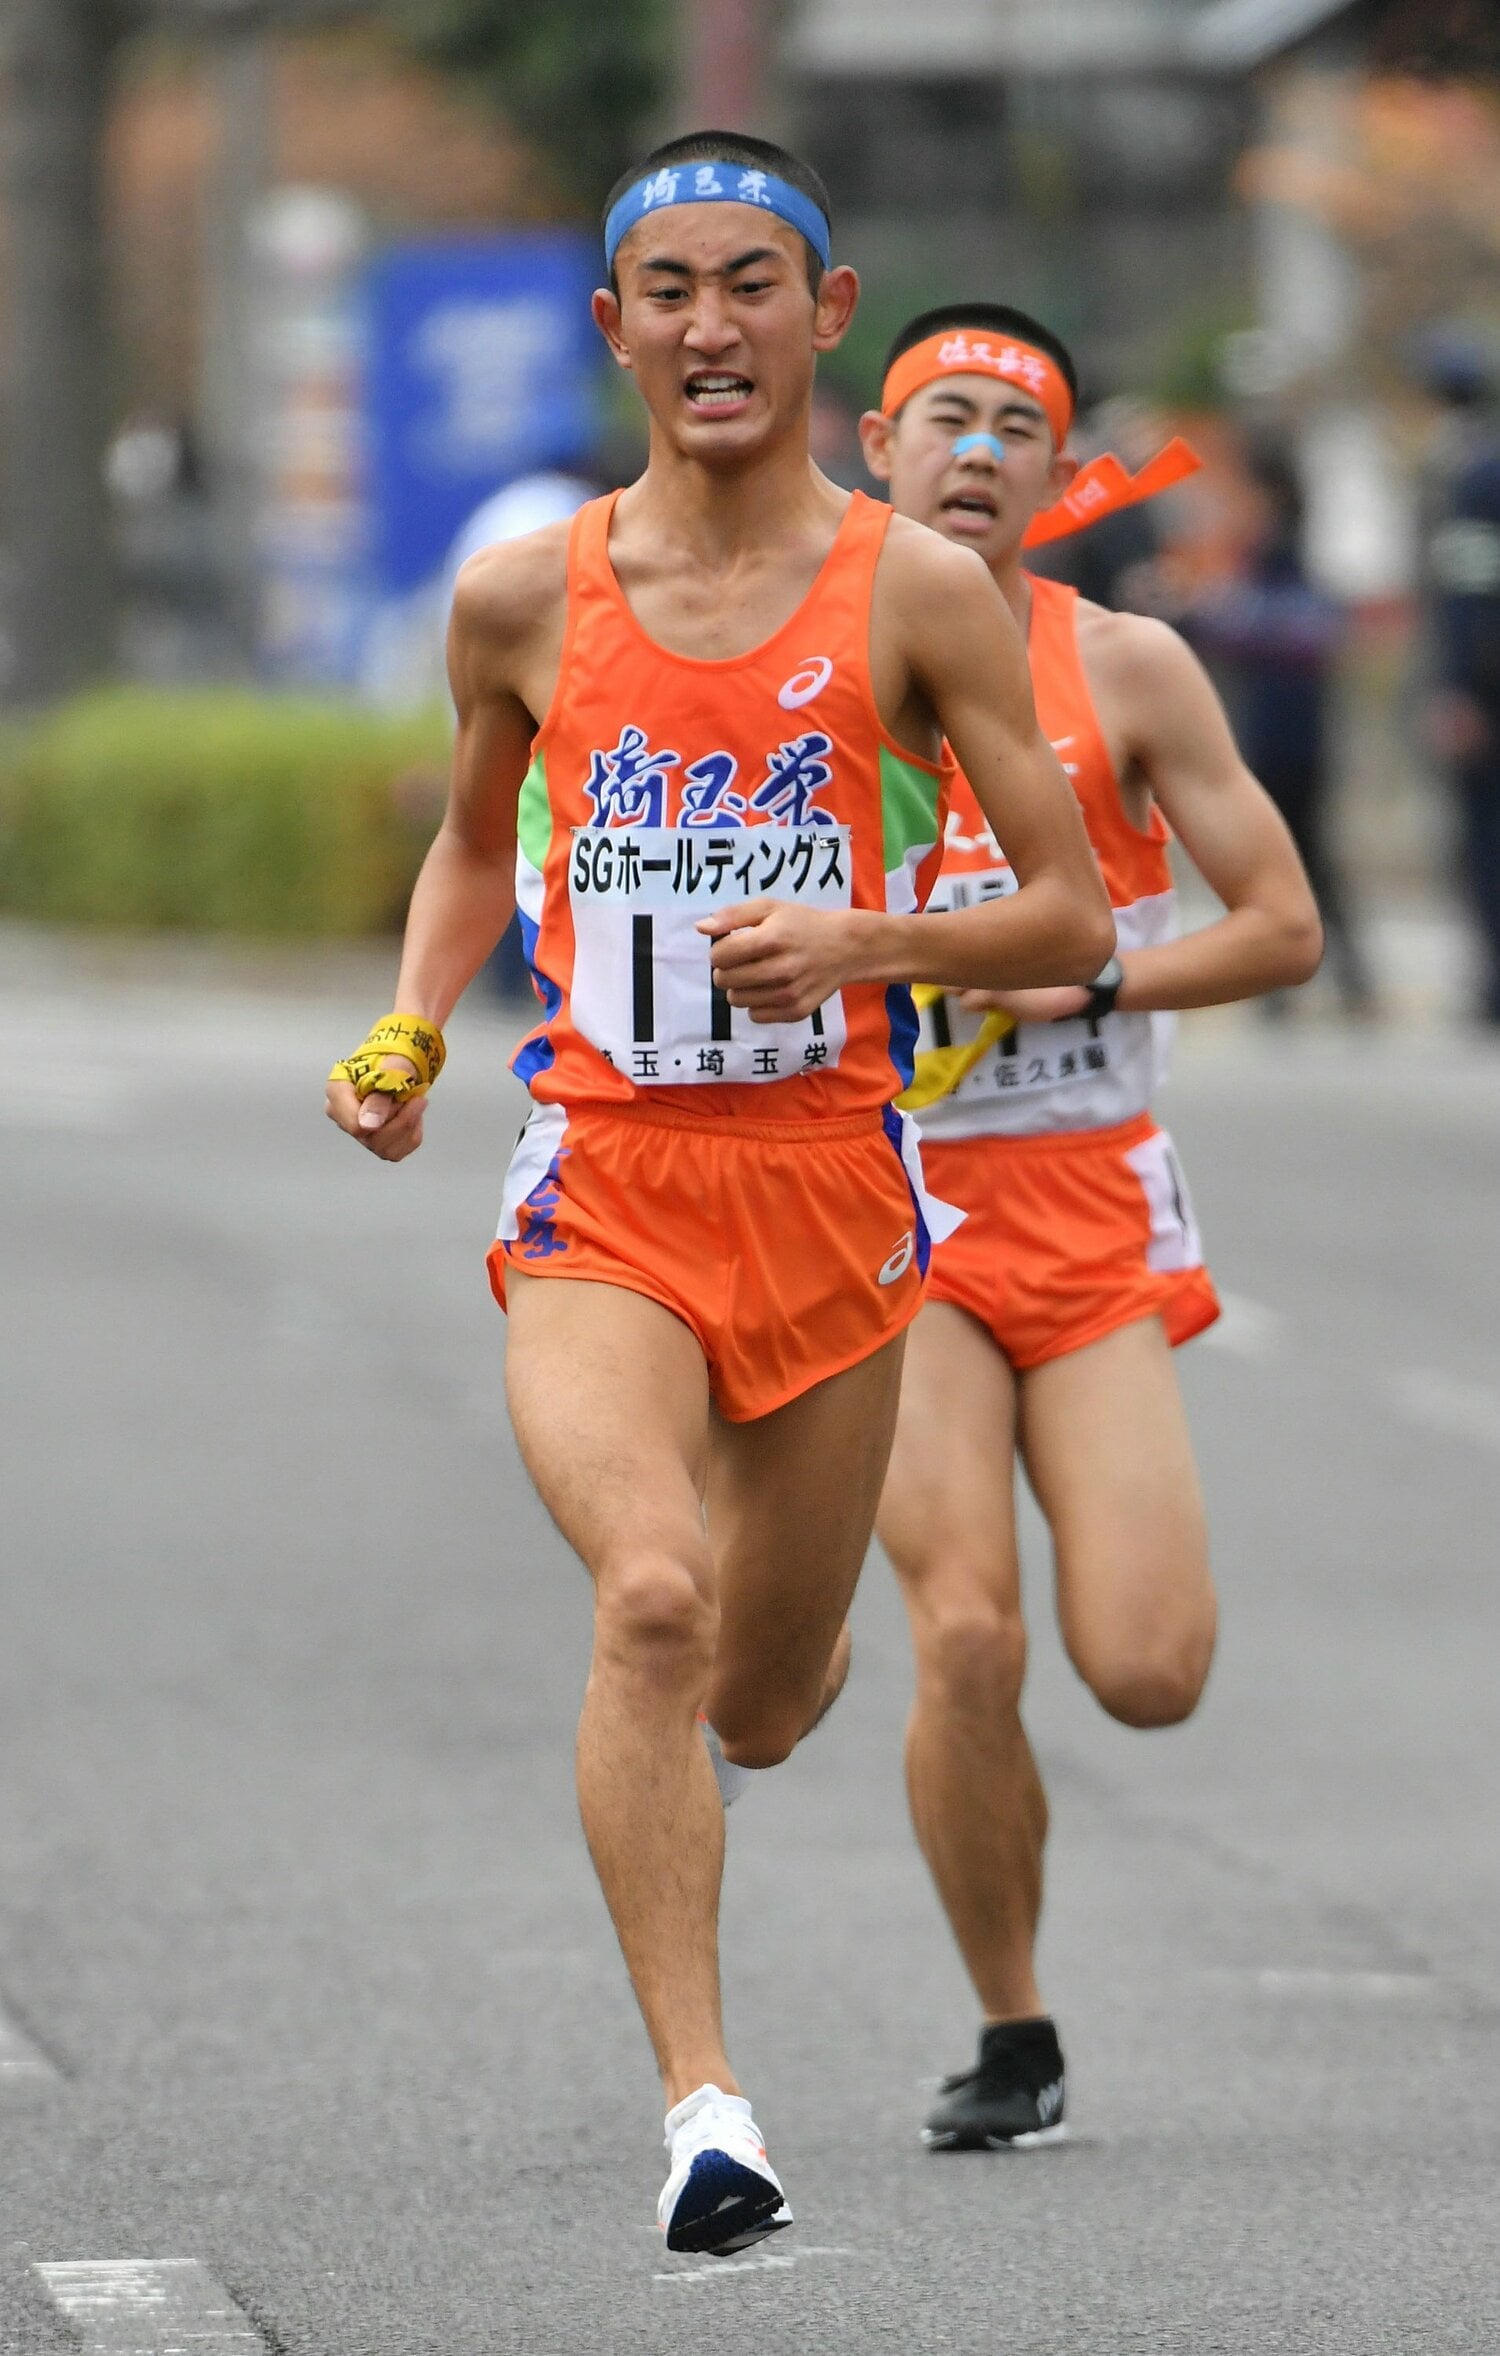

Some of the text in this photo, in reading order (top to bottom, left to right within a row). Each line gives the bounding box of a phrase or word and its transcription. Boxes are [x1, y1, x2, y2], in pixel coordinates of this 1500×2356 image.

[573, 831, 844, 895] SGホールディングス
